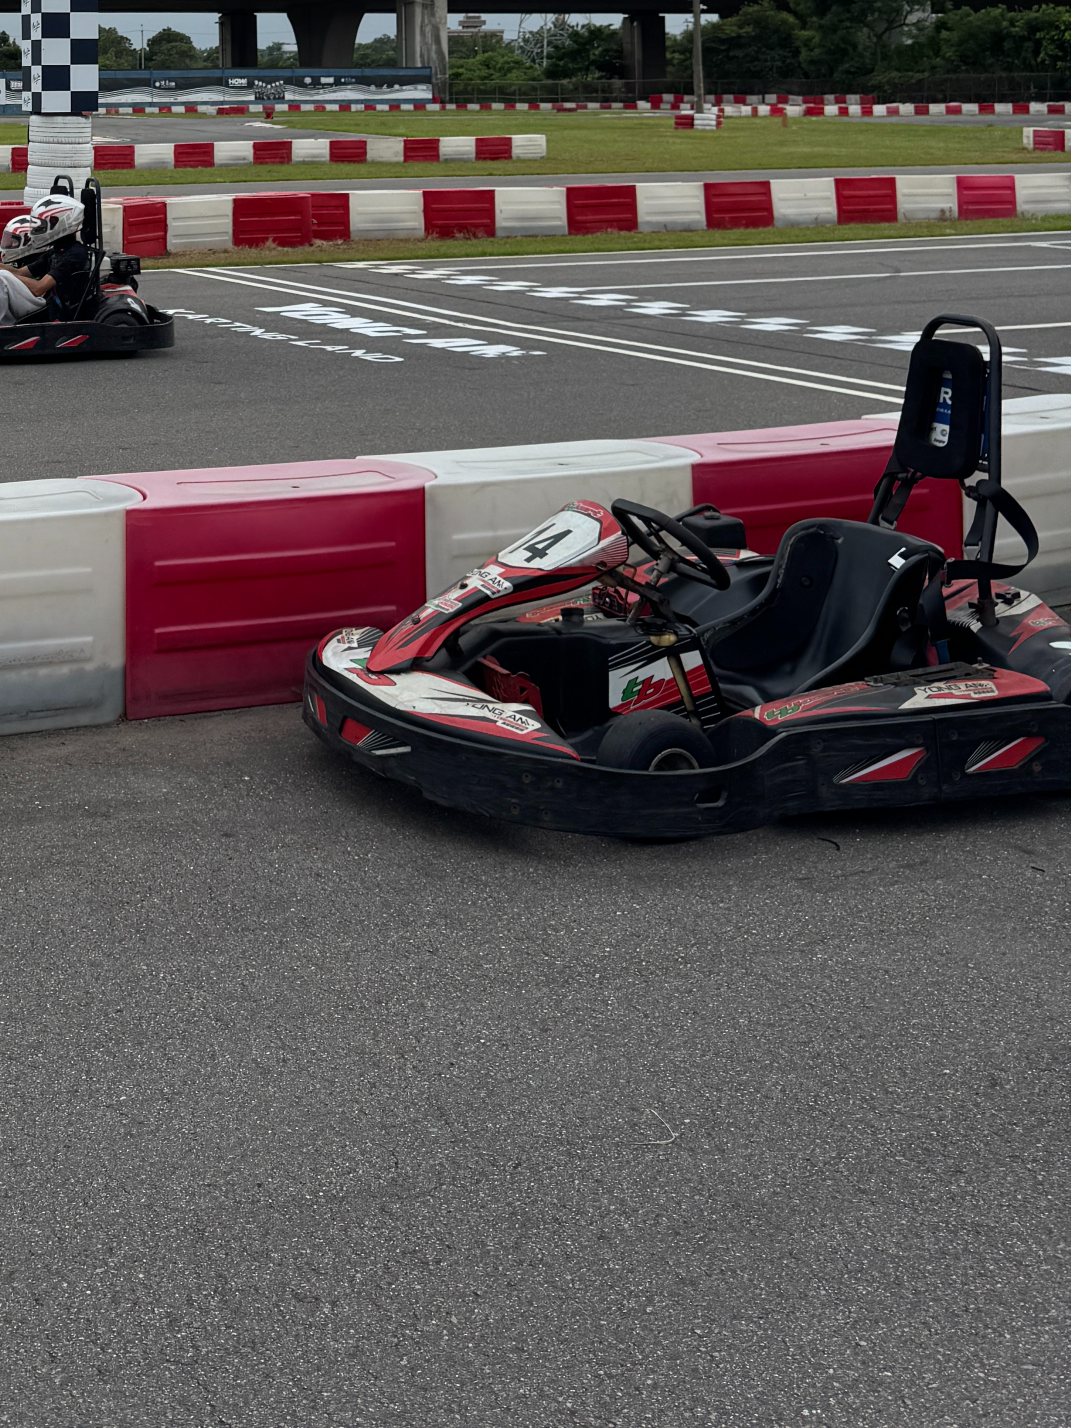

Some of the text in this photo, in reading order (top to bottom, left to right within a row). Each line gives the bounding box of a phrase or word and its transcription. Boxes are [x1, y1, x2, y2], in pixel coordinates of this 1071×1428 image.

[159, 308, 404, 362] KARTING LAND
[255, 303, 427, 337] YONG
[508, 523, 573, 563] 14
[917, 684, 961, 693] YONG
